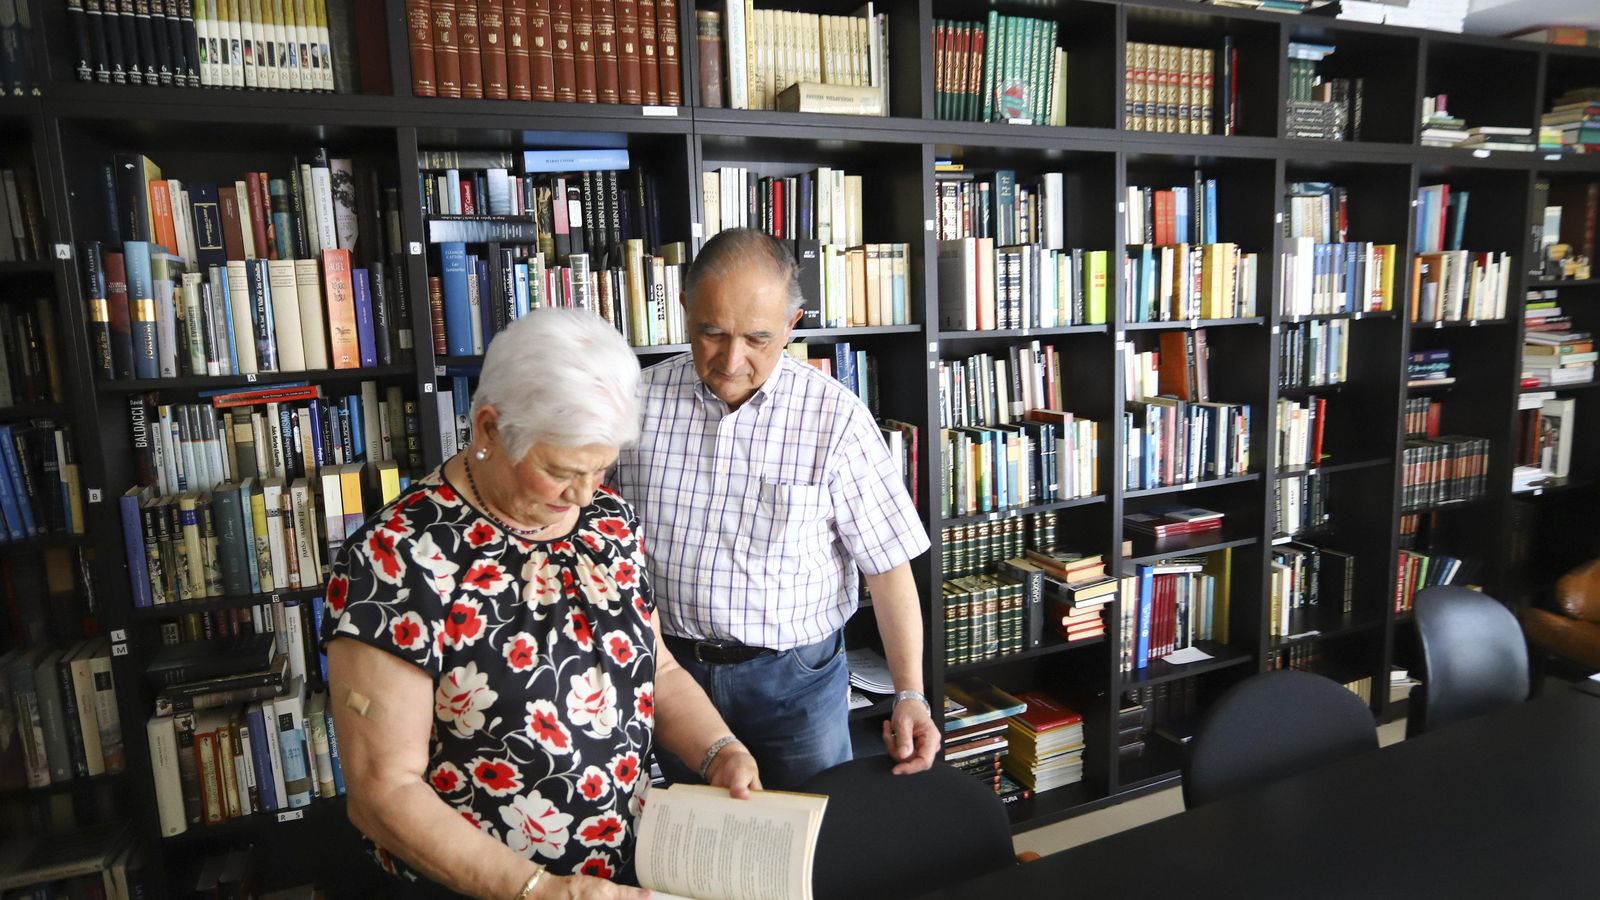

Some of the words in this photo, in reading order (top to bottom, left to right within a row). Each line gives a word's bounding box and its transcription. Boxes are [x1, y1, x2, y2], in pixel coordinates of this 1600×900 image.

[81, 60, 86, 68] 2
[162, 64, 166, 72] 6
[148, 66, 153, 74] 5
[189, 68, 194, 76] 8
[204, 68, 207, 76] 1
[212, 68, 219, 76] 2
[224, 68, 230, 77] 3
[235, 70, 240, 78] 4
[248, 70, 254, 78] 5
[260, 70, 266, 79] 6
[271, 70, 276, 79] 7
[282, 71, 288, 80] 8
[292, 72, 298, 80] 9
[302, 72, 312, 80] 10
[314, 72, 322, 81] 11
[323, 72, 332, 81] 12
[595, 177, 604, 200] CARRÉ
[609, 177, 617, 200] CARRÉ
[586, 201, 592, 210] LE
[598, 201, 604, 210] LE
[612, 200, 618, 209] LE
[60, 249, 66, 258] A
[656, 284, 664, 320] BANCO
[131, 408, 148, 448] BALDACCI
[281, 412, 292, 437] ABISMO
[1003, 796, 1018, 804] TURA
